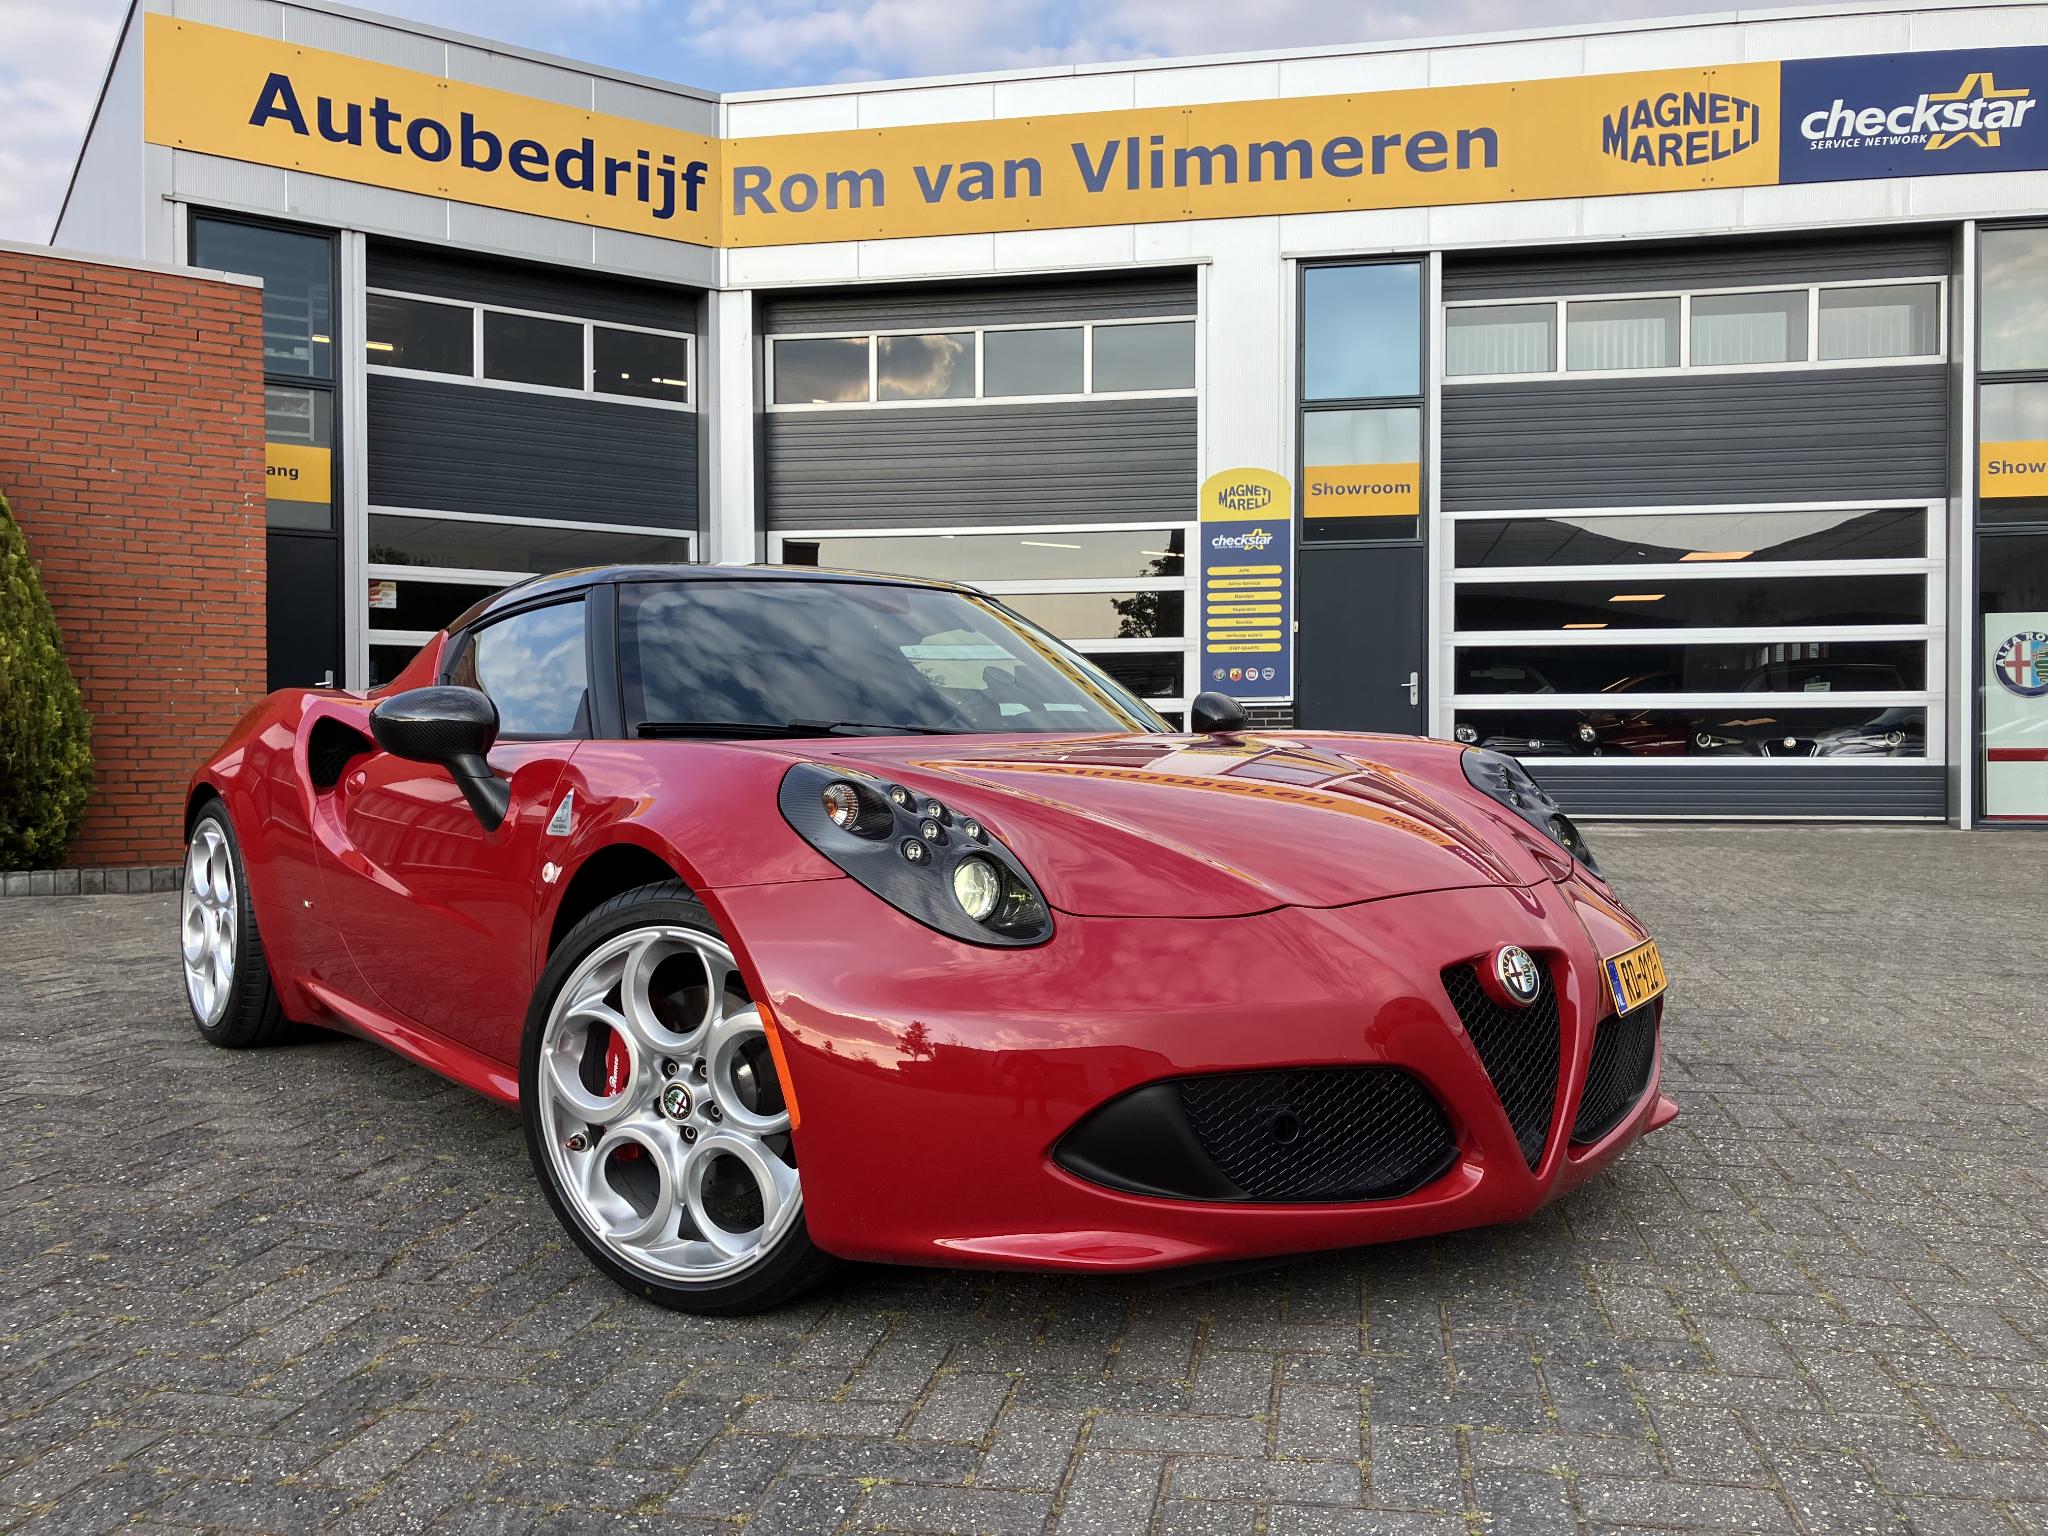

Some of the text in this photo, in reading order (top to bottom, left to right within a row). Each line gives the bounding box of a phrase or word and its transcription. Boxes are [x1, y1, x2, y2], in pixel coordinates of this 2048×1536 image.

[1602, 91, 1760, 138] MAGNETI
[1801, 93, 2036, 141] checkstar
[248, 72, 708, 219] Autobedrijf
[1602, 125, 1760, 167] MARELLI
[1810, 134, 1927, 150] SERVICE NETWORK
[731, 126, 1499, 216] Rom van Vlimmeren
[1218, 484, 1271, 501] MAGNETI
[1218, 495, 1271, 511] MARELLI
[1311, 482, 1411, 496] Showroom
[1211, 534, 1273, 547] checkstar
[1996, 636, 2021, 668] ALFA
